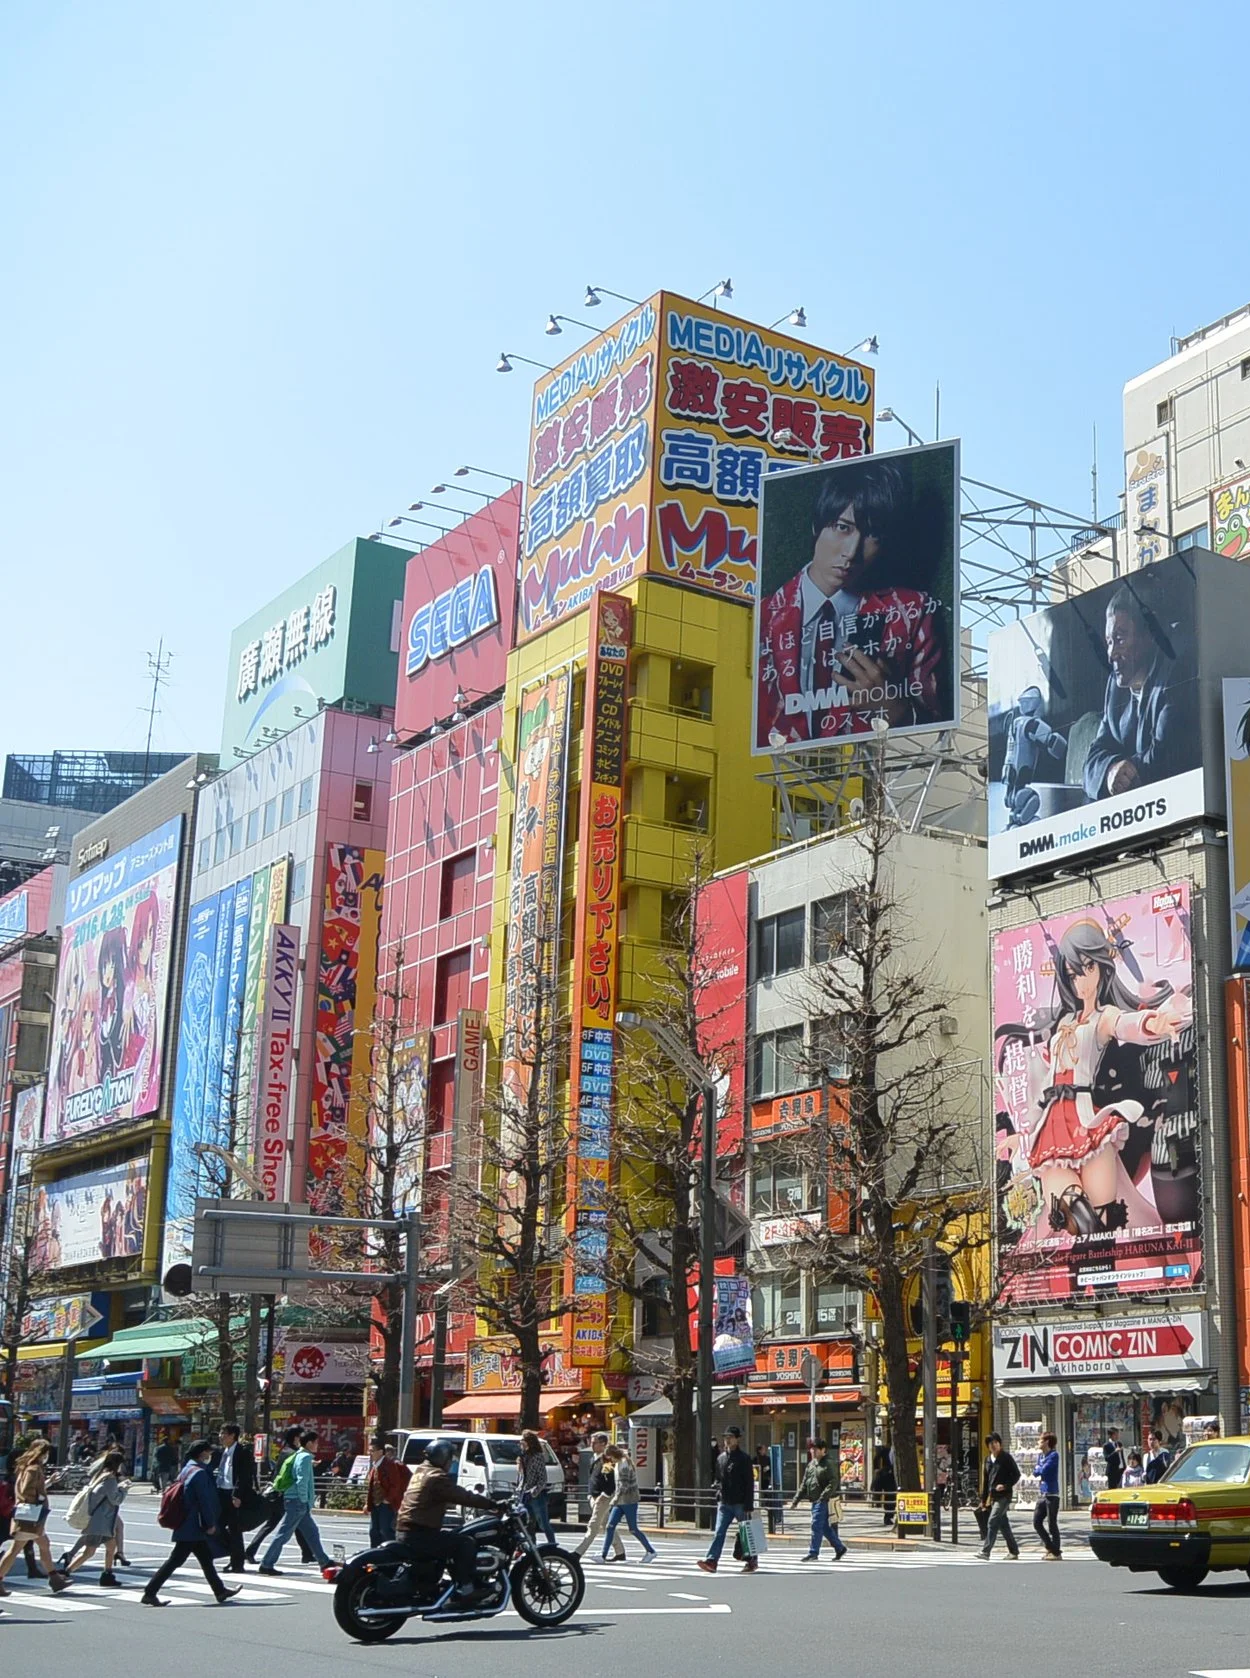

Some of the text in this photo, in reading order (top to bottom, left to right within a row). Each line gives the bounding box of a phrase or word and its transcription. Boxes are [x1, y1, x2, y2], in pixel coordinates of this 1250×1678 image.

[535, 302, 655, 428] MEDIAリサイクル
[667, 311, 872, 404] MEDIAリサイクル
[533, 354, 652, 488] 激安販売
[664, 355, 867, 461] 激安販売
[526, 420, 647, 555] 高額買取
[522, 503, 648, 630] Mulan
[679, 562, 743, 593] ムーラン
[405, 565, 498, 677] SEGA
[567, 586, 594, 609] AKIBA
[761, 597, 952, 655] よほど自信があるか、
[601, 662, 625, 678] DVD
[761, 636, 913, 682] あるいはアホか。
[601, 703, 619, 716] CD
[784, 679, 924, 716] DMM mobile
[1100, 797, 1168, 834] ROBOTS
[77, 838, 108, 869] Sofmap
[70, 856, 129, 913] ソフマップ
[273, 929, 298, 1004] AKKY
[1011, 938, 1038, 1058] 勝利を!
[464, 1018, 480, 1071] GAME
[581, 1030, 612, 1044] 6F中古
[584, 1050, 610, 1061] DVD
[265, 1028, 291, 1134] Tax-free
[581, 1062, 612, 1076] 5F中古
[582, 1081, 610, 1094] DVD
[1003, 1040, 1032, 1159] 提督に!!
[1124, 1243, 1164, 1256] HARUNA
[1001, 1326, 1048, 1374] ZIN
[1054, 1361, 1111, 1373] Akihabara
[1056, 1330, 1157, 1360] COMIC ZIN
